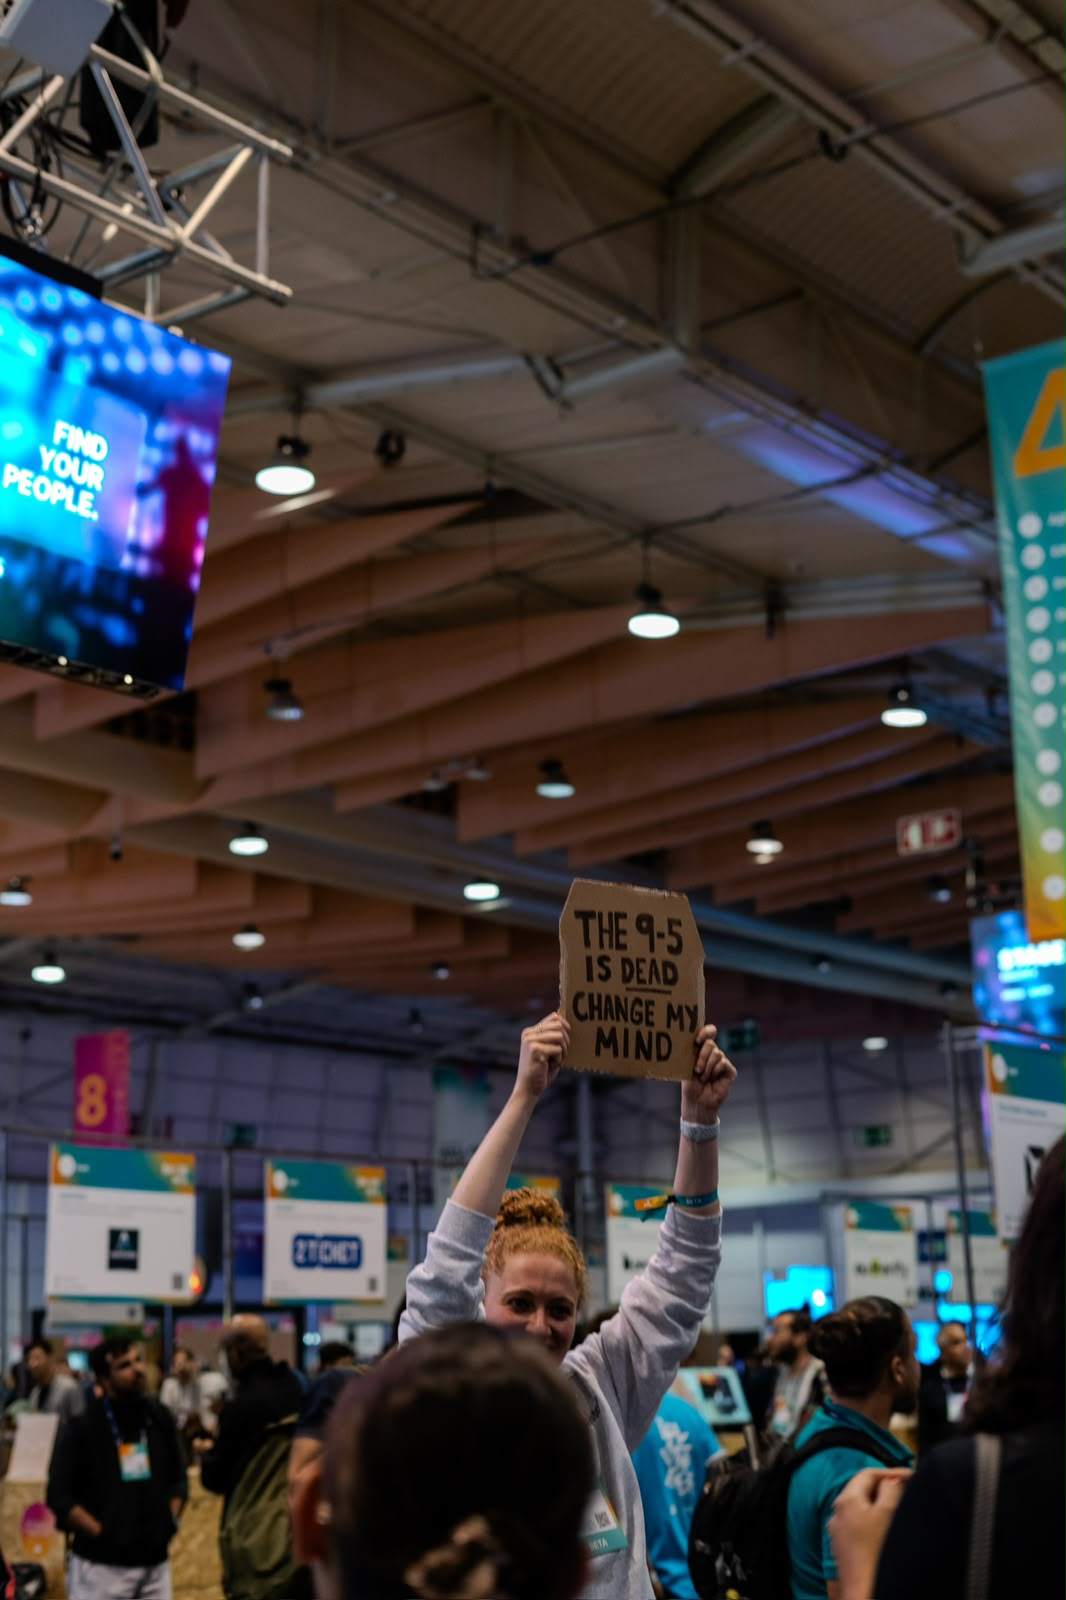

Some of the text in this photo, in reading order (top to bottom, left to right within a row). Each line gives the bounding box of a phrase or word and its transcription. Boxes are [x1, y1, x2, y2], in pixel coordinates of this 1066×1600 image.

[53, 420, 108, 461] FIND
[40, 445, 104, 491] YOUR
[3, 464, 98, 520] PEOPLE.
[574, 910, 683, 956] THE 9-5
[585, 955, 679, 986] IS DEAD
[572, 992, 699, 1033] CHANGE MY
[595, 1026, 672, 1062] MIND
[76, 1074, 108, 1127] 8
